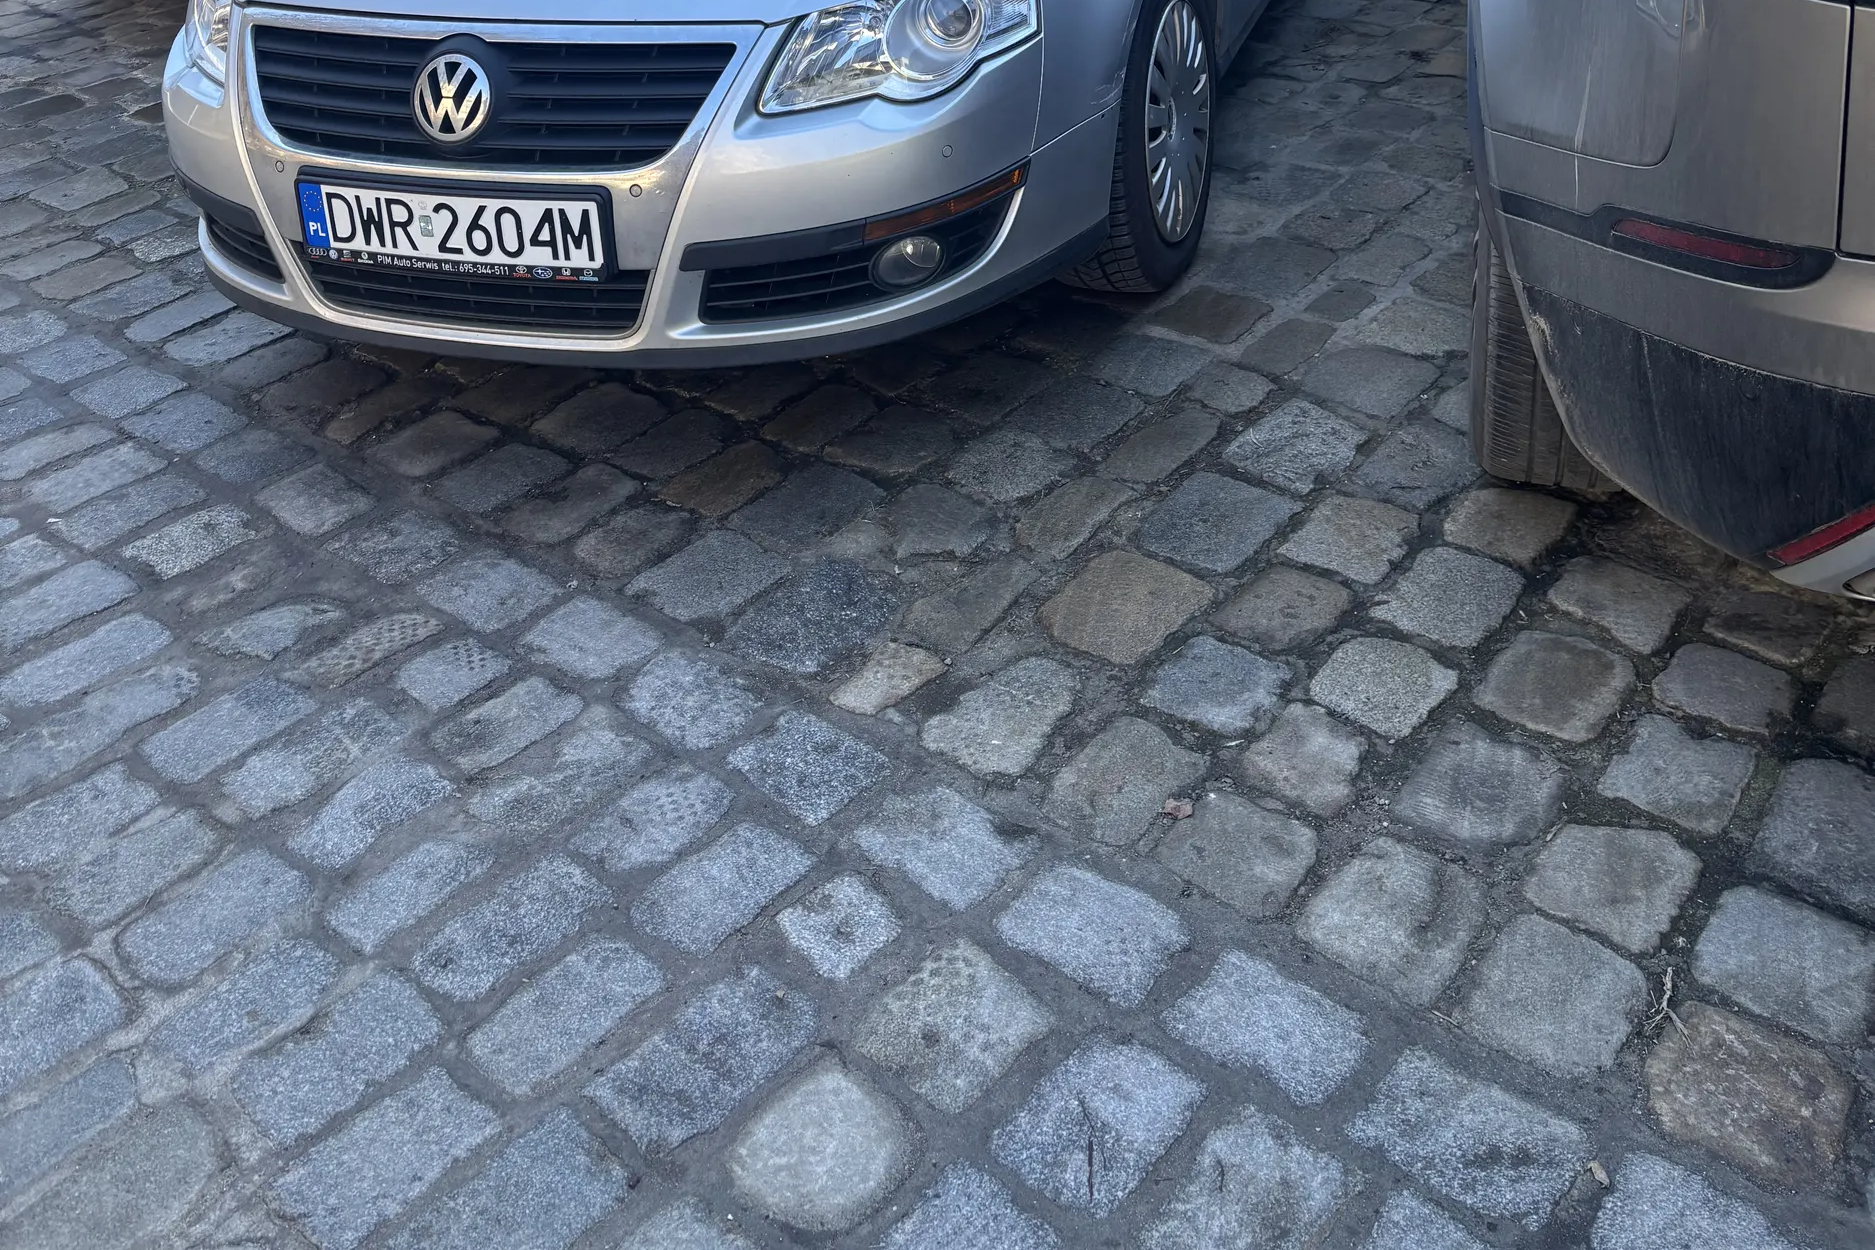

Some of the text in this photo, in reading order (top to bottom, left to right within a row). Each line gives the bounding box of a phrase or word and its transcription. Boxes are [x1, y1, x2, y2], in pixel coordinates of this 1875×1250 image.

[309, 221, 326, 238] PL
[325, 192, 596, 262] DWR 2604M
[377, 254, 509, 276] PIM Auto Serwis tel.: 695-344-511
